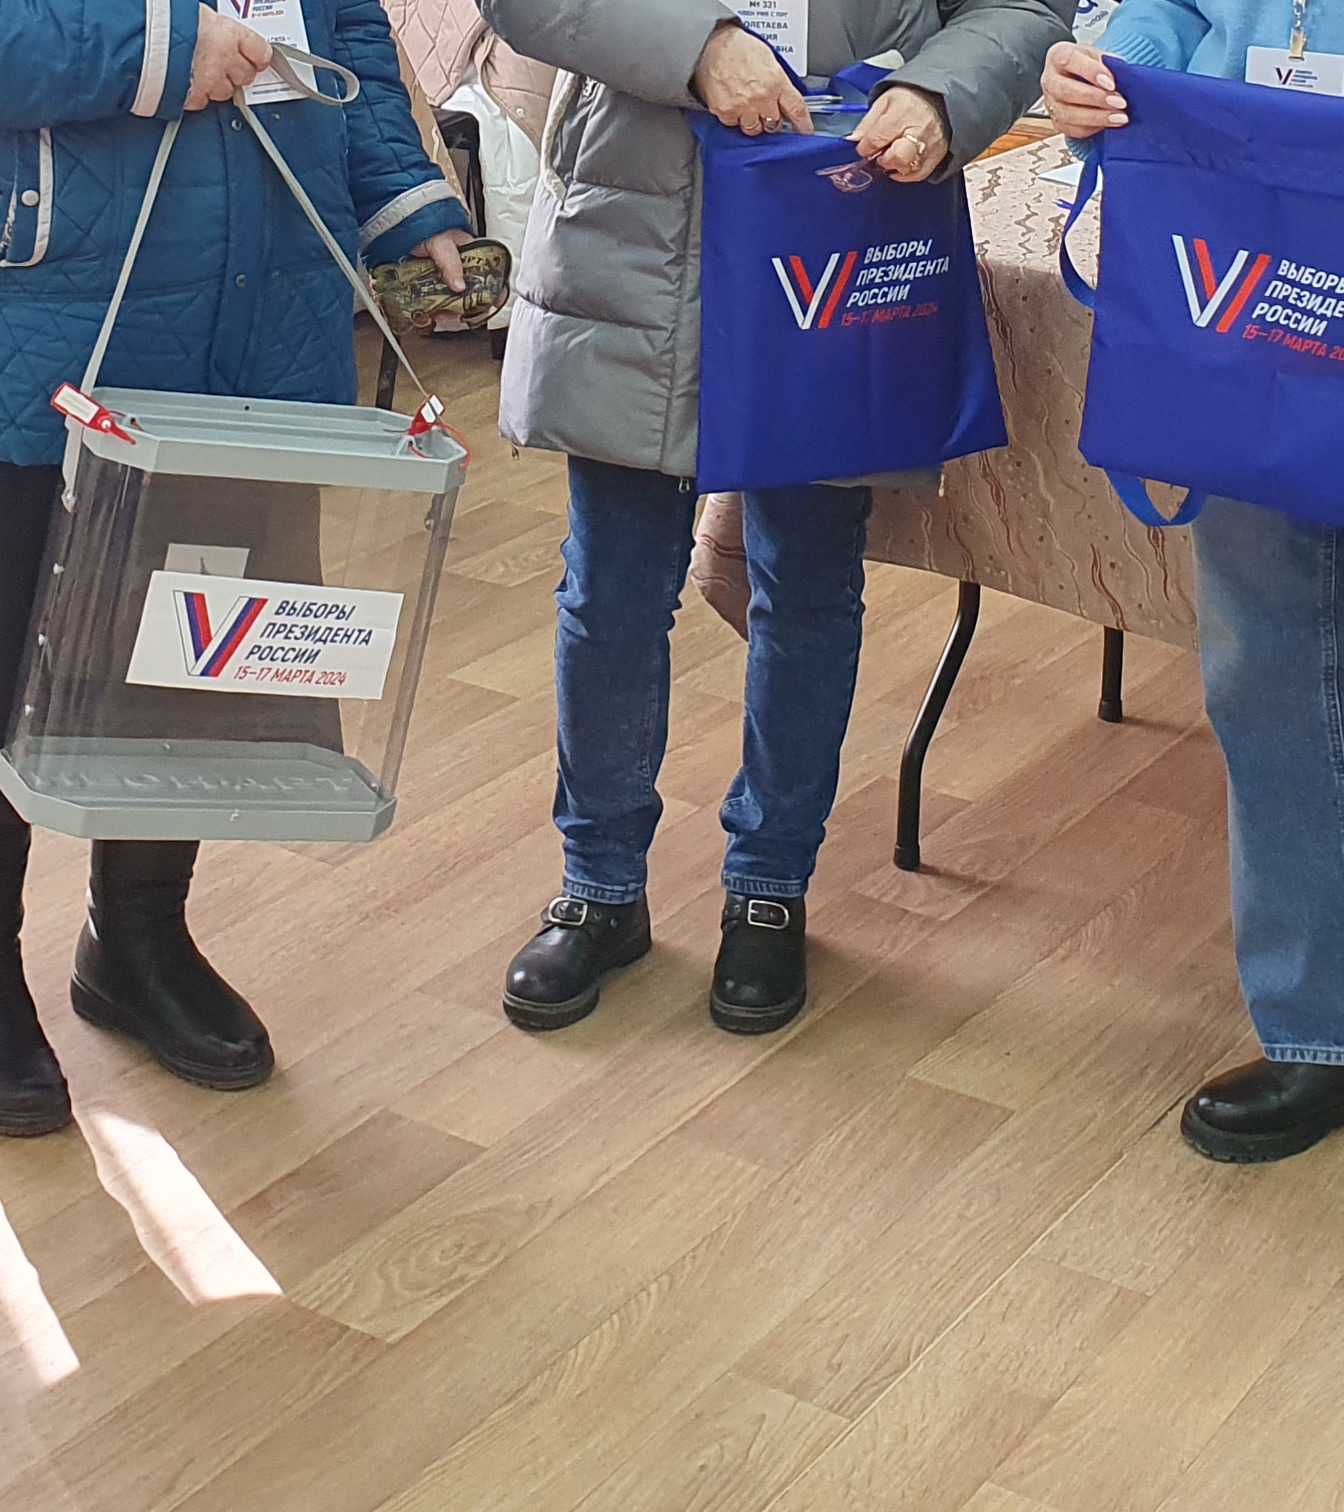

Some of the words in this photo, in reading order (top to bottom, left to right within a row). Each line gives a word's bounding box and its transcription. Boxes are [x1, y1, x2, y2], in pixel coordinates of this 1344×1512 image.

[863, 239, 933, 264] ВЫБОРЫ
[856, 256, 950, 286] ПРЕЗИДЕНТА
[846, 284, 911, 308] РОССИИ
[1251, 302, 1328, 336] РОССИИ
[1282, 333, 1328, 357] МАРТА
[274, 600, 356, 621] ВЫБОРЫ
[259, 622, 373, 646] ПРЕЗИДЕНТА
[244, 644, 321, 664] РОССИИ
[269, 667, 316, 684] МАРТА
[314, 670, 347, 686] 2024
